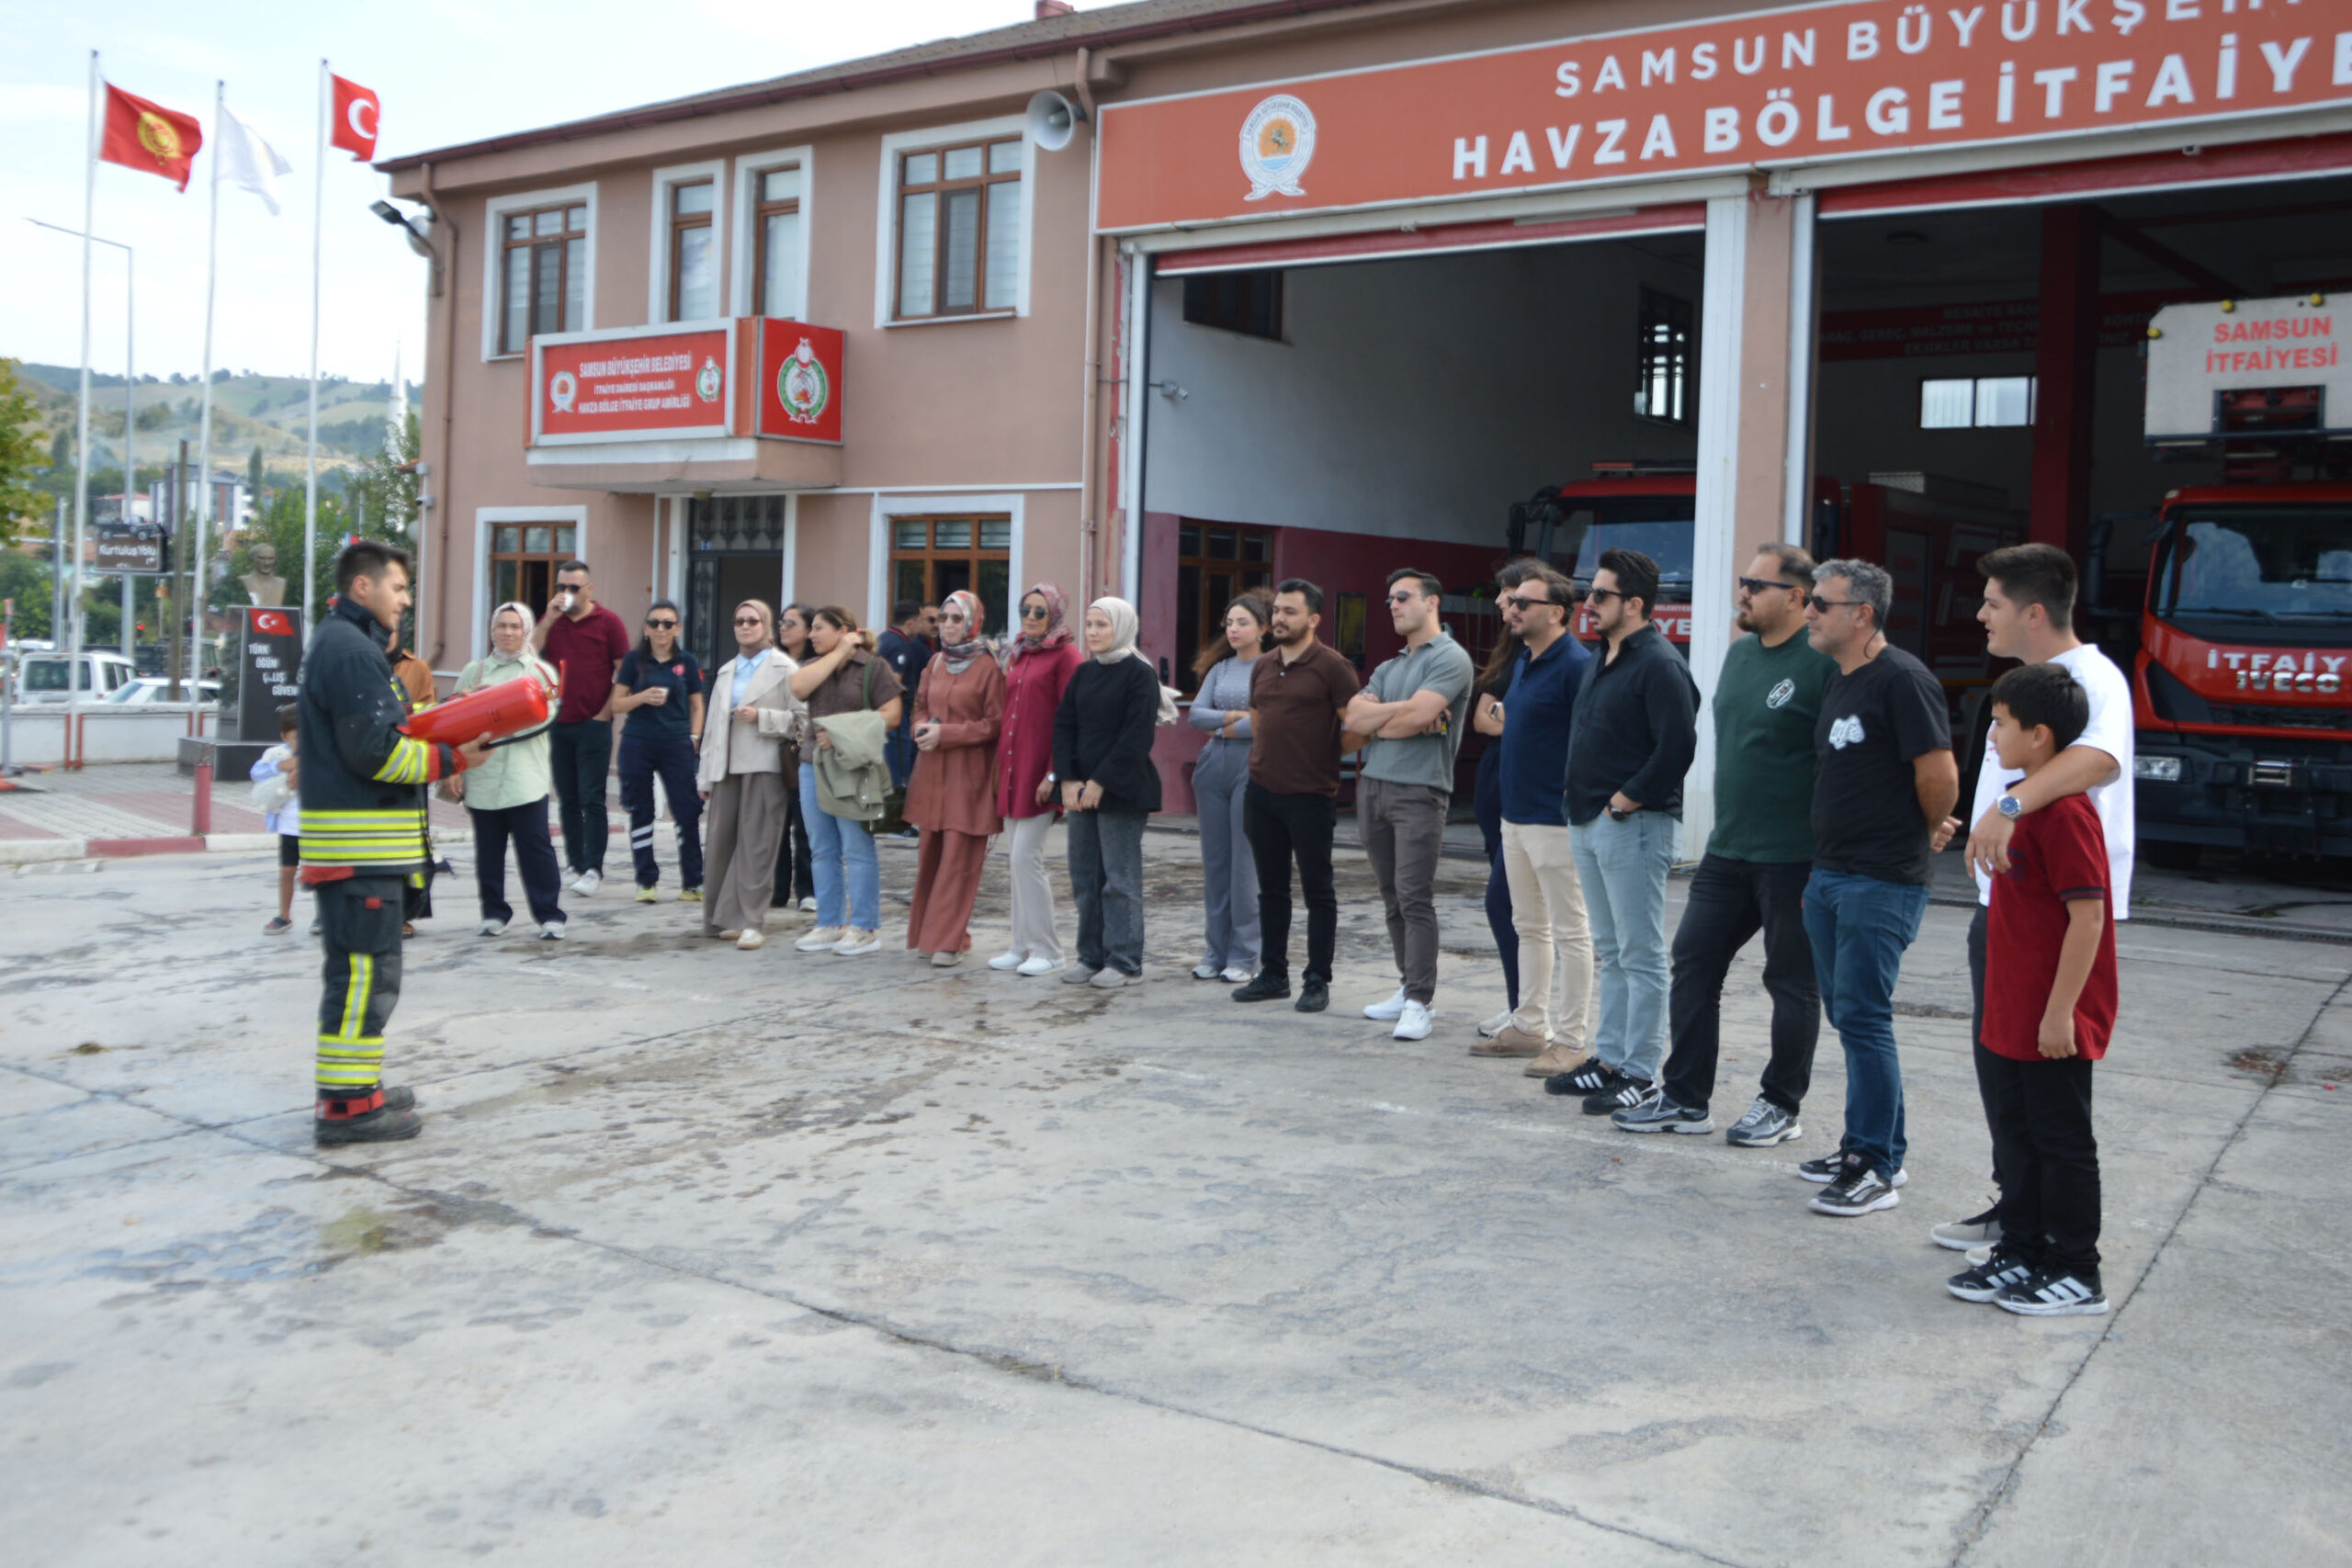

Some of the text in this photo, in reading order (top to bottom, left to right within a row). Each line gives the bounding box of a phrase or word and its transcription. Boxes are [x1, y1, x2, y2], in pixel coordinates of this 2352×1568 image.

[1555, 28, 1816, 97] SAMSUN
[1453, 113, 1679, 180] HAVZA
[1703, 79, 1964, 153] BÖLGE
[2214, 316, 2332, 343] SAMSUN
[579, 350, 692, 378] SAMSUN BÜYÜKŞEHİR BELEDİYESİ
[2206, 341, 2338, 373] İTFAİYESİ
[248, 643, 270, 655] TÜRK
[2207, 649, 2352, 673] İTFAİY
[272, 683, 300, 696] GÜVEN
[2236, 670, 2341, 694] IVECO
